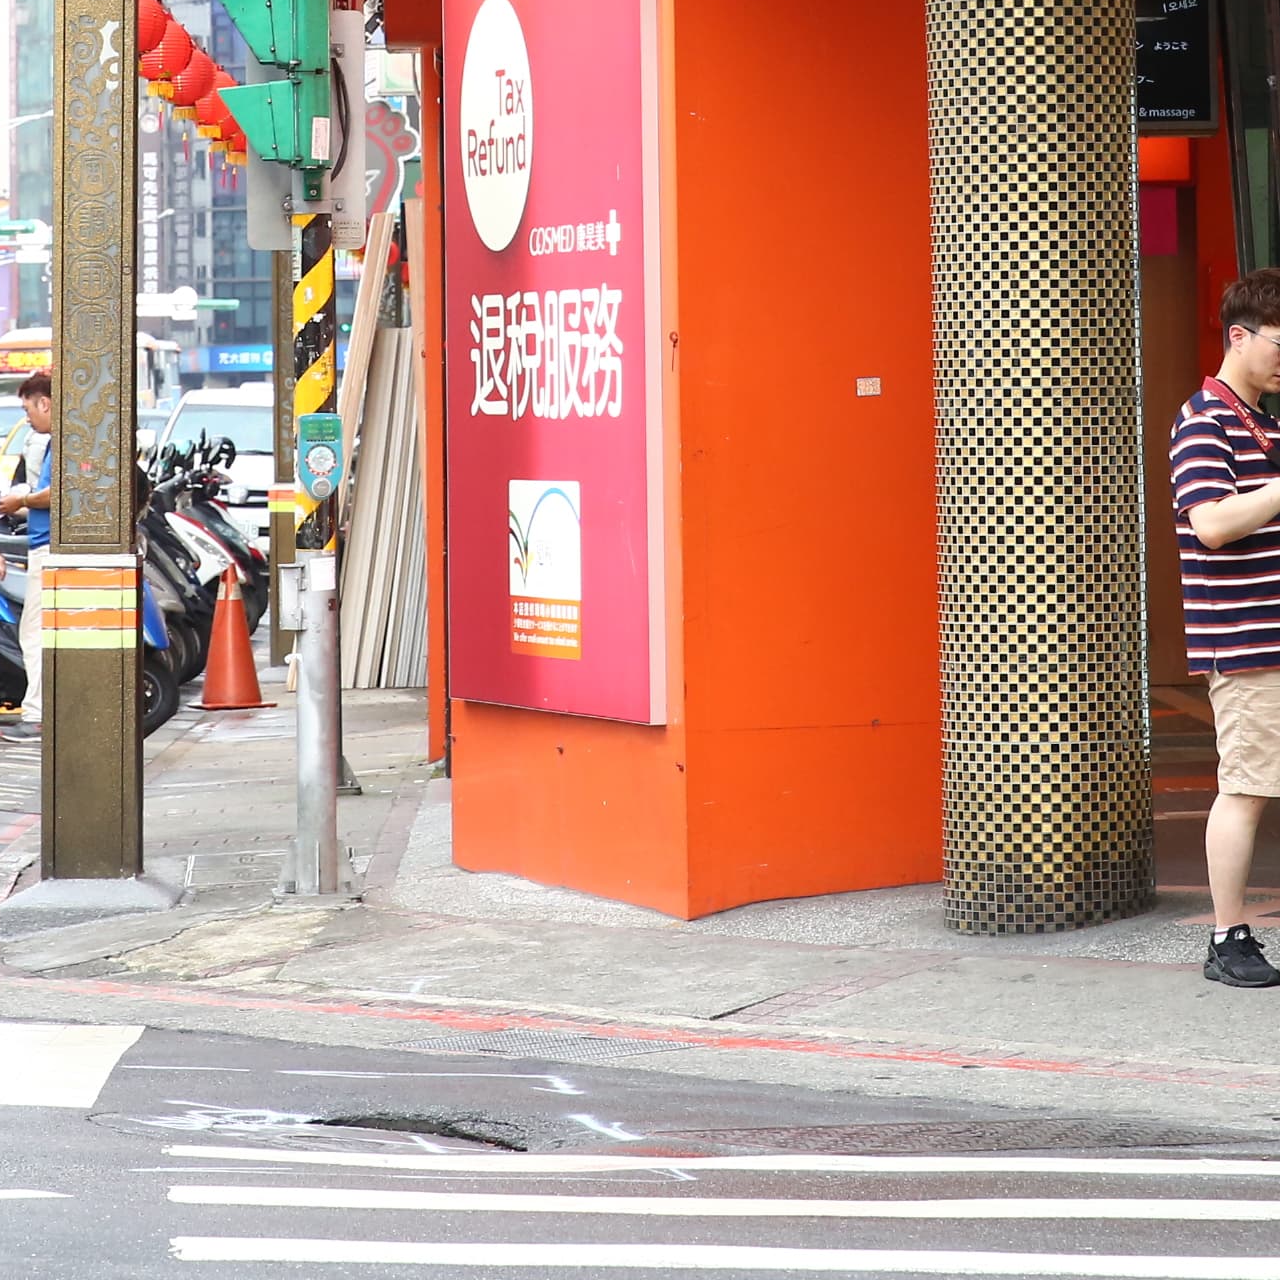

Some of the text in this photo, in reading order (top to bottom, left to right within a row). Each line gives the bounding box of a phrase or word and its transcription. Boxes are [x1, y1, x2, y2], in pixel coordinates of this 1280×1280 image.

[495, 69, 524, 114] Tax
[1149, 109, 1196, 119] massage
[467, 114, 526, 178] Refund
[529, 221, 606, 257] COSMED 康是美
[471, 282, 623, 421] 退稅服務
